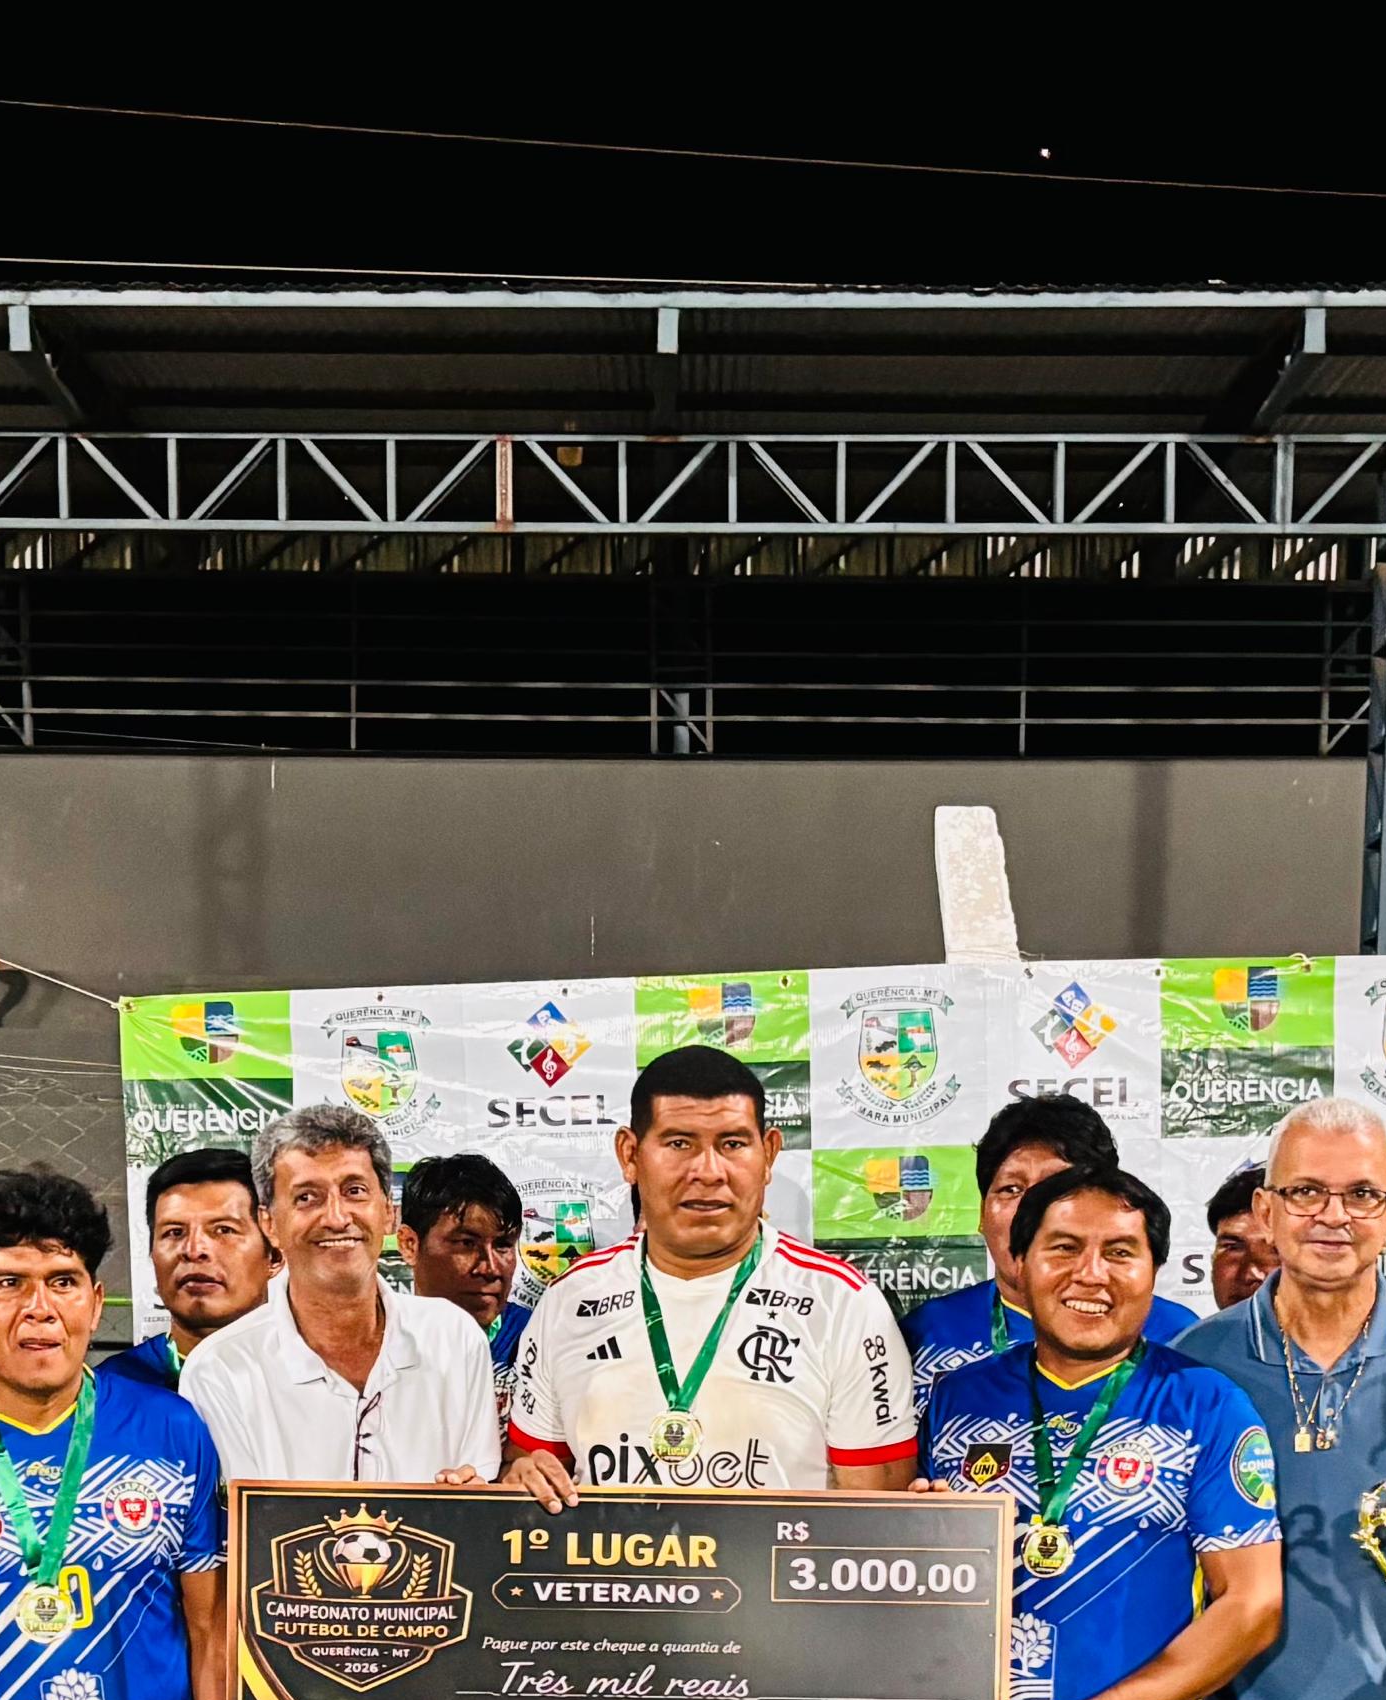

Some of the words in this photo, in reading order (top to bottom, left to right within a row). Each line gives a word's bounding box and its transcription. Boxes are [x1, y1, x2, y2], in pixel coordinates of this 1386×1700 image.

[856, 987, 915, 1001] QUERÊNCIA
[924, 990, 939, 999] MT
[335, 1007, 394, 1022] QUERÊNCIA
[488, 1094, 618, 1129] SECEL
[893, 1094, 954, 1123] MUNICIPAL
[862, 1261, 976, 1291] ERÊNCIA
[597, 1290, 635, 1317] BRB
[769, 1290, 814, 1316] BRB
[974, 1464, 995, 1476] UNI
[777, 1520, 810, 1542] R$
[502, 1528, 550, 1564] 1º
[566, 1531, 717, 1568] LUGAR
[788, 1557, 977, 1596] 3.000,00
[533, 1581, 701, 1604] VETERANO
[266, 1601, 370, 1621] CAMPEONATO
[374, 1605, 458, 1621] MUNICIPAL
[274, 1621, 352, 1637] FUTEBOL
[357, 1624, 380, 1637] DE
[383, 1625, 449, 1638] CAMPO
[312, 1645, 380, 1657] QUERÊNCIA
[392, 1649, 411, 1658] MT
[482, 1636, 528, 1653] Pague
[531, 1640, 559, 1652] por
[561, 1640, 590, 1651] este
[593, 1638, 647, 1655] cheque
[649, 1643, 659, 1652] a
[662, 1641, 719, 1656] quantia
[722, 1641, 742, 1655] de
[344, 1662, 379, 1674] 2026
[500, 1661, 575, 1695] Três
[586, 1664, 656, 1696] mil
[664, 1674, 750, 1698] reais
